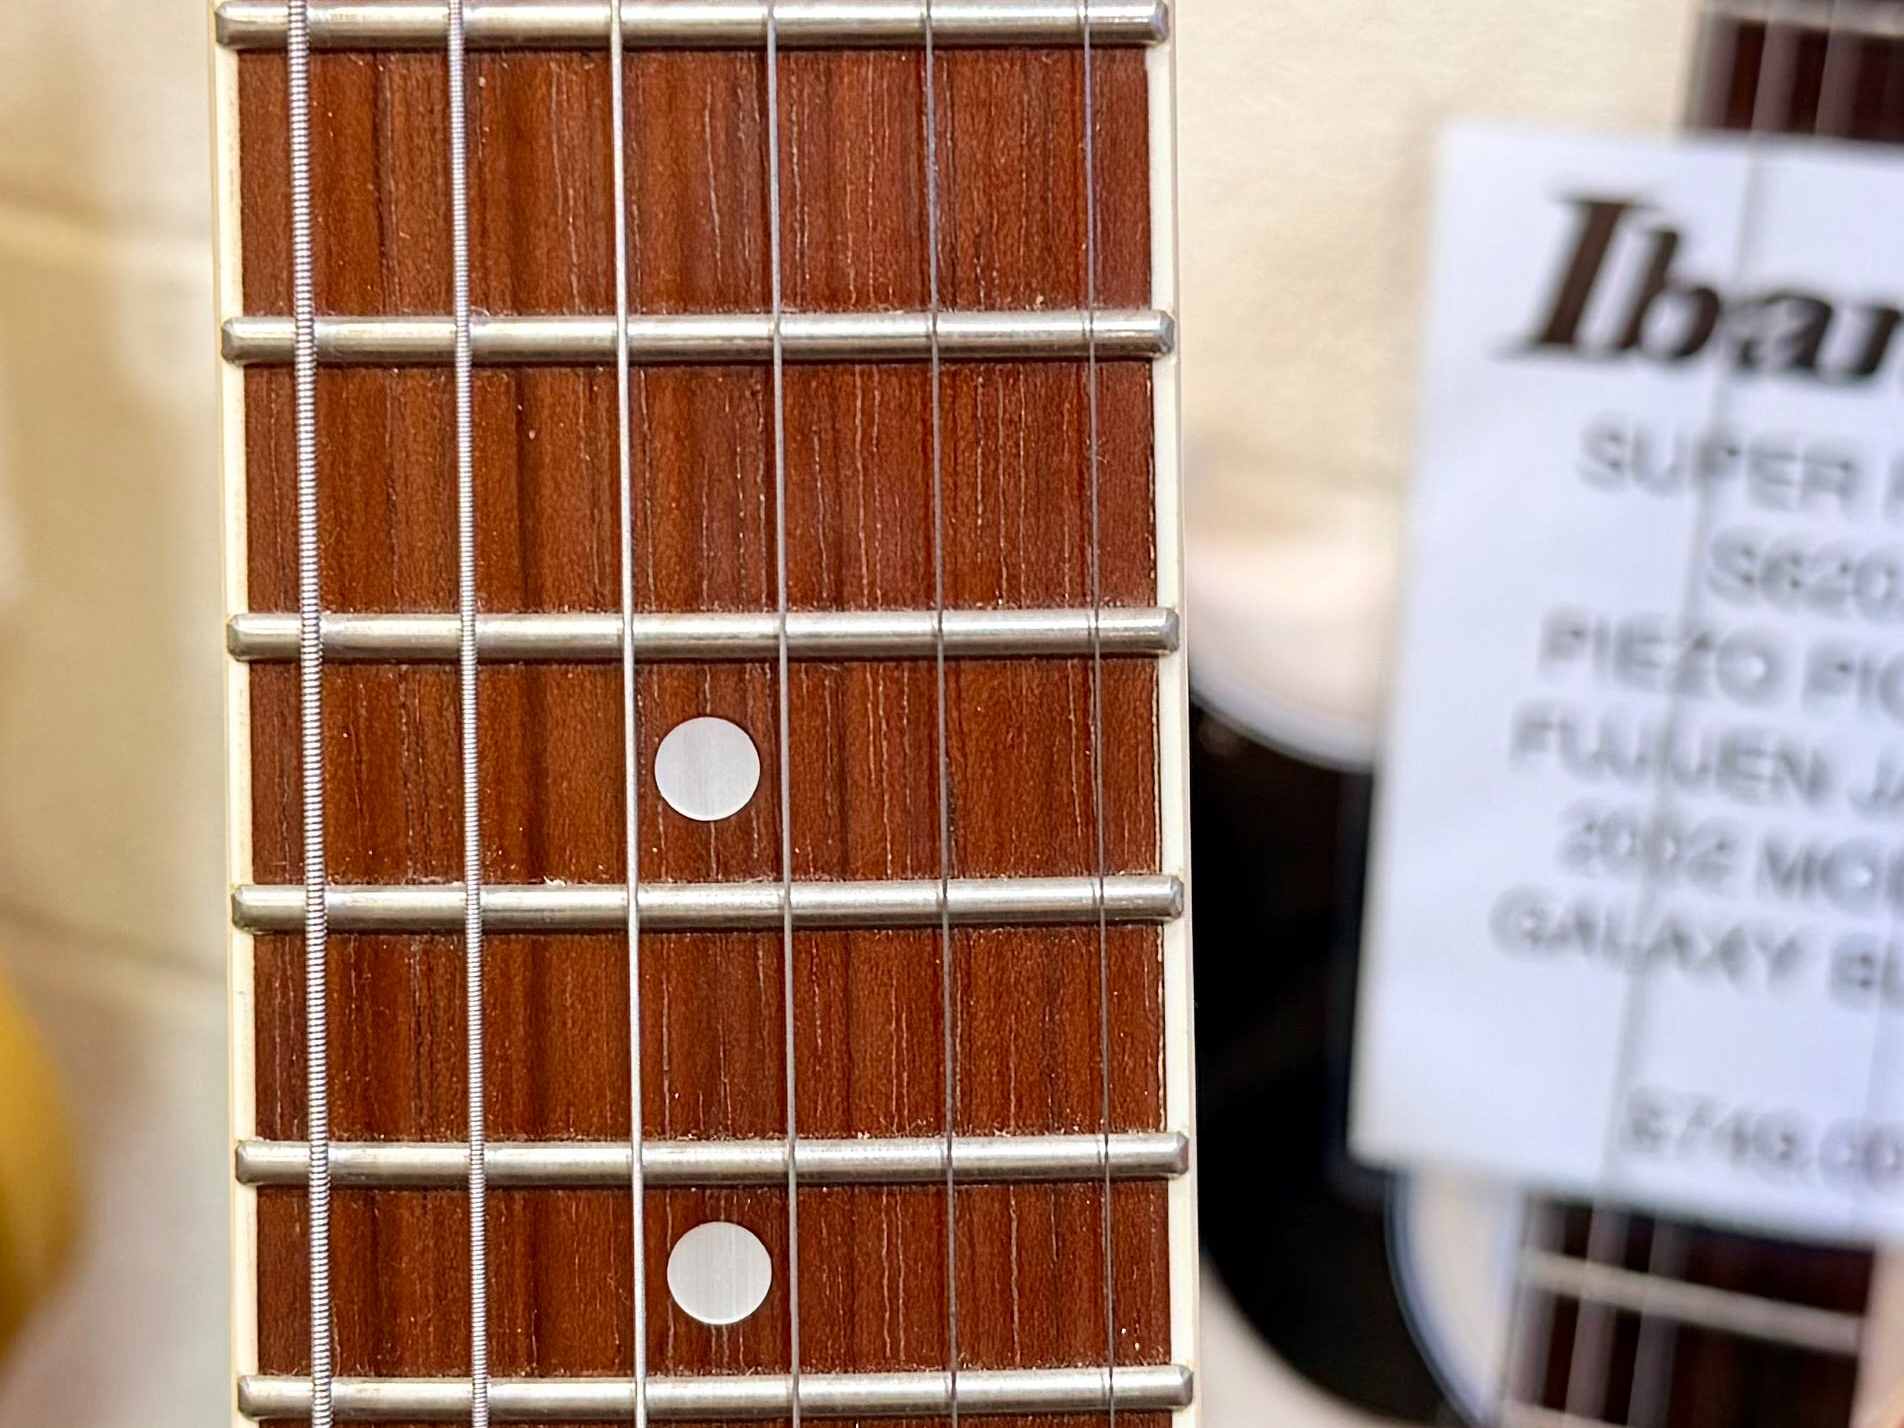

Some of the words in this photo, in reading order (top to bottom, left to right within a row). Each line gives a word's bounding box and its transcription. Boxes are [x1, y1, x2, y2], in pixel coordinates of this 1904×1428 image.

[1578, 417, 1862, 524] SUPER
[1537, 606, 1779, 712] PIEZO
[1556, 802, 1736, 892] 2002
[1486, 886, 1810, 988] GALAXY
